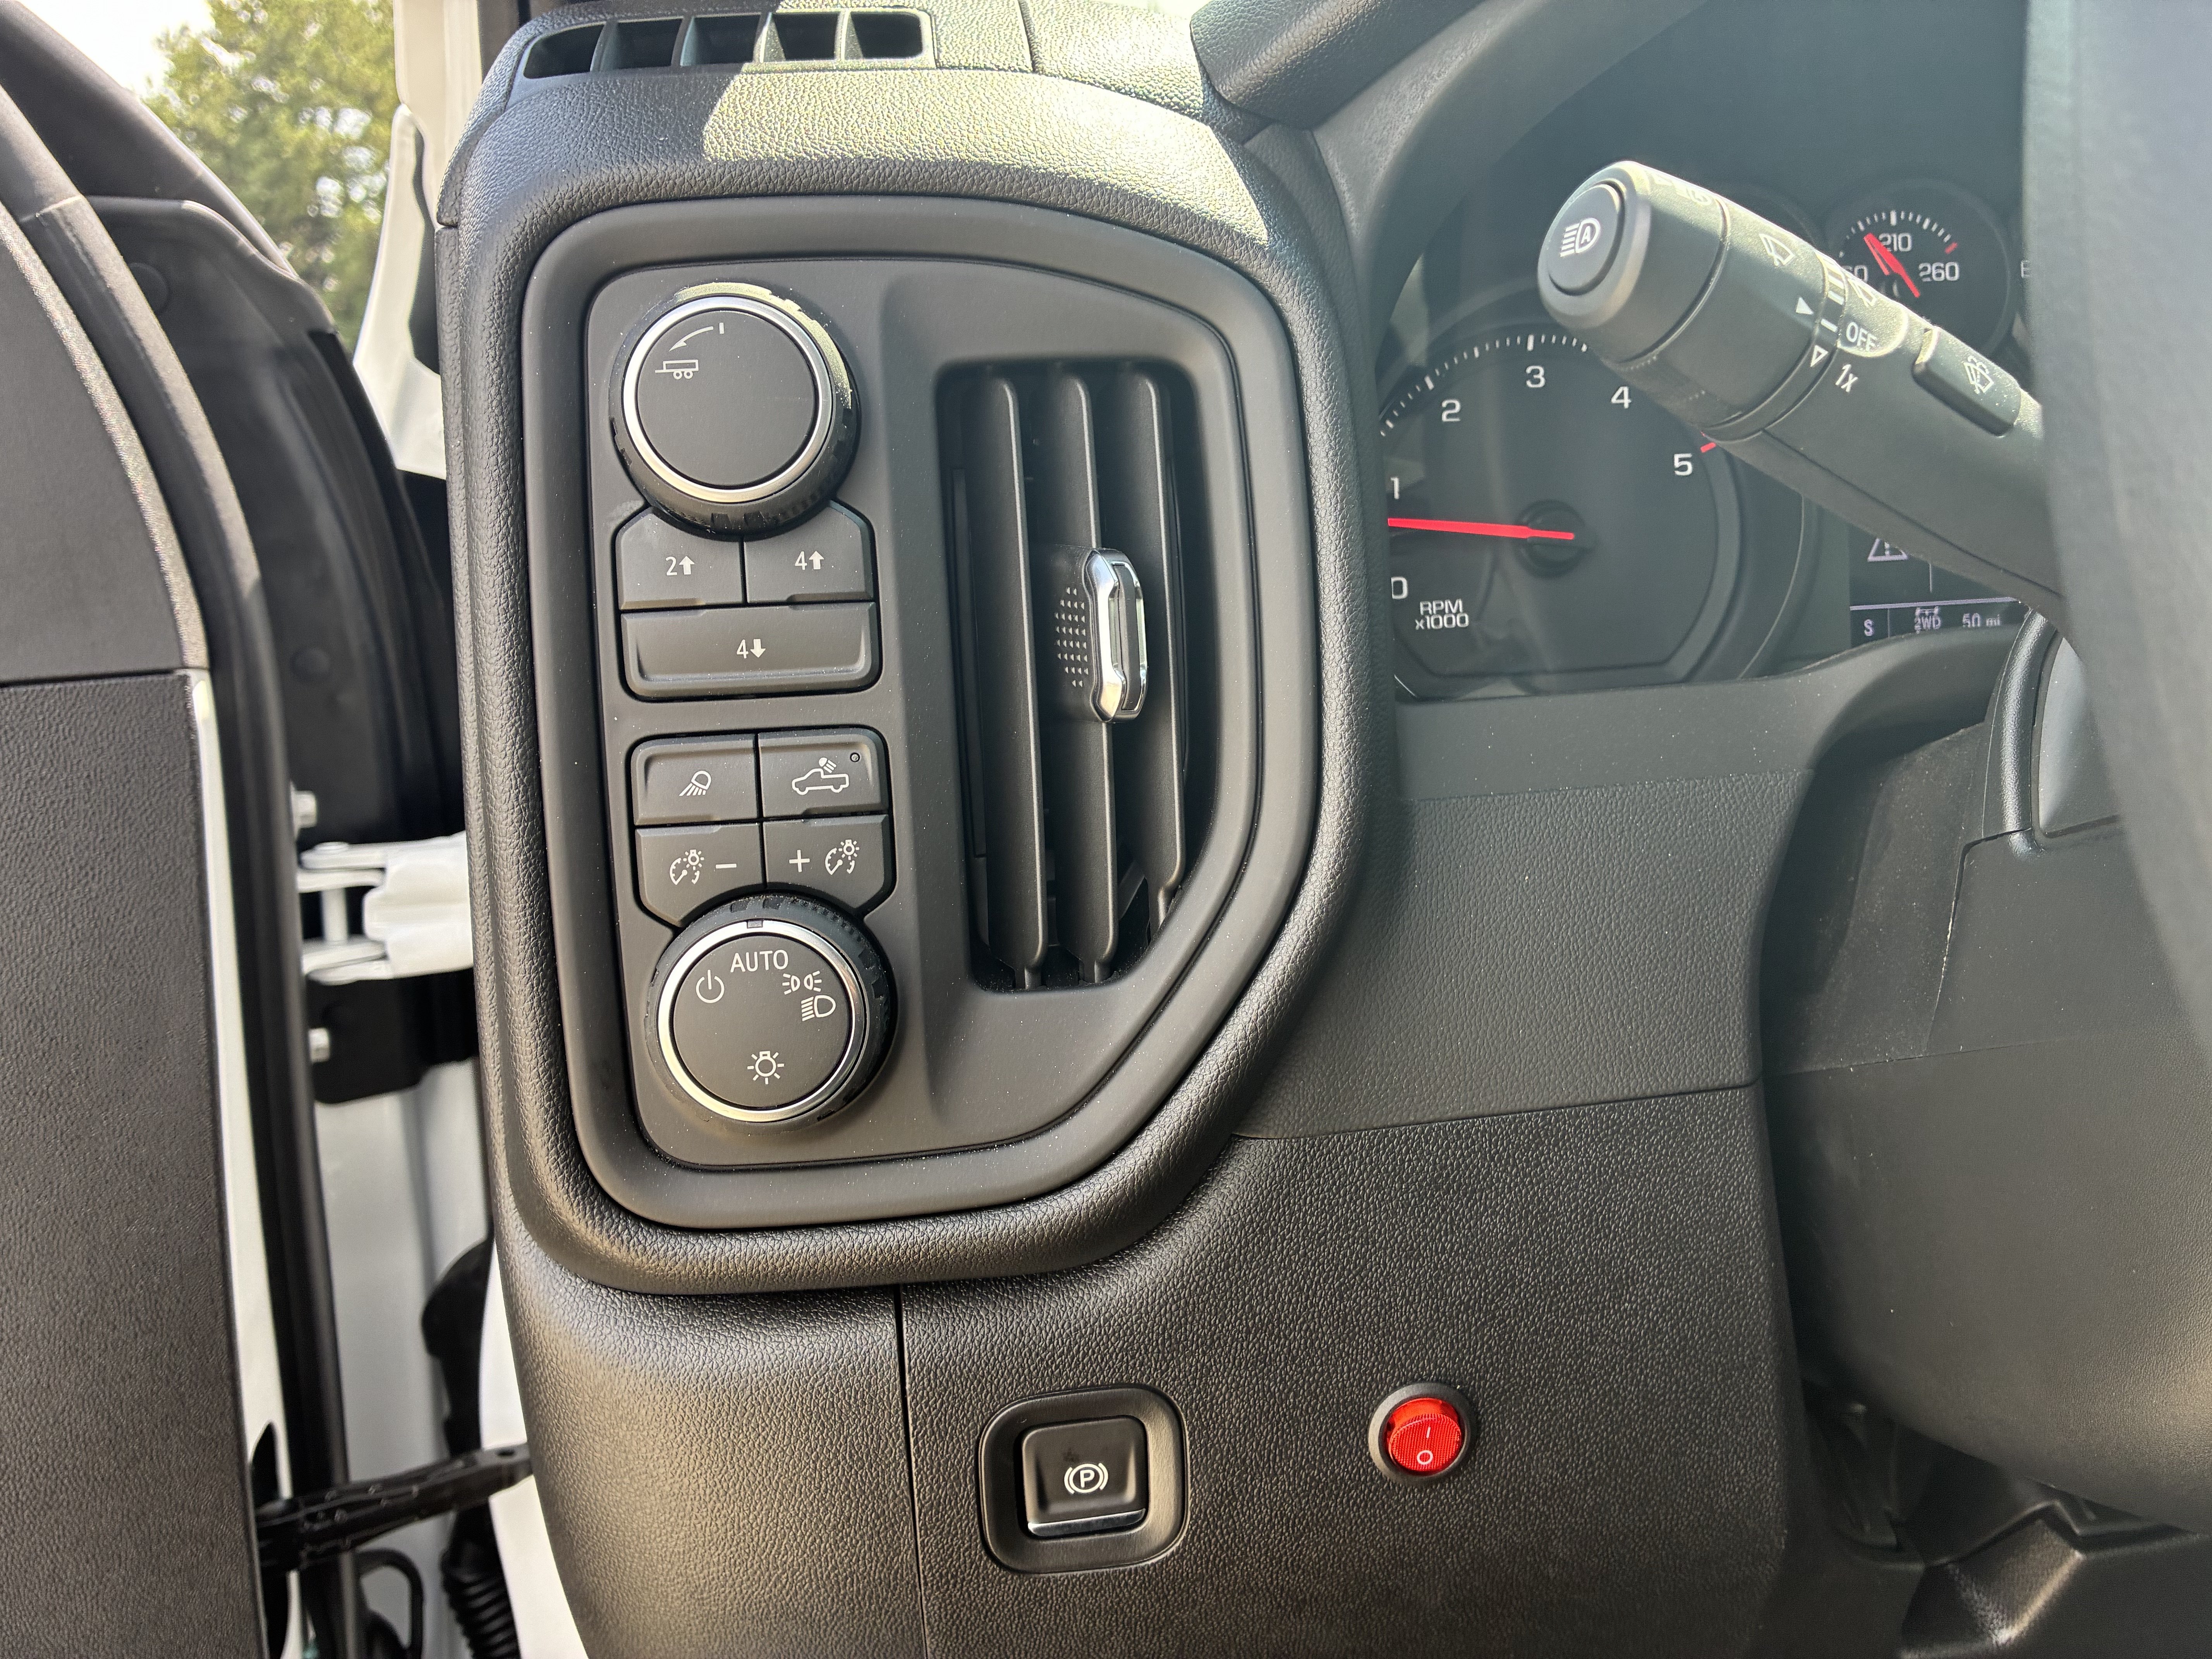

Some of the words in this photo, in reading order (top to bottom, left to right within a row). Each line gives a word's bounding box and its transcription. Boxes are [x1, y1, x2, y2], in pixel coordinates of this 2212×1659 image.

[1879, 232, 1912, 252] 210
[1918, 261, 1960, 282] 260
[1846, 322, 1877, 351] OFF
[1525, 366, 1546, 388] 3
[1835, 364, 1858, 392] 1x
[1611, 386, 1632, 409] 4
[1441, 399, 1461, 422] 2
[1674, 453, 1693, 476] 5
[1390, 477, 1400, 499] 1
[1391, 576, 1408, 599] 0
[1420, 598, 1463, 615] RPM
[1415, 613, 1469, 630] x1000
[1864, 619, 1875, 637] S
[730, 950, 788, 972] AUTO
